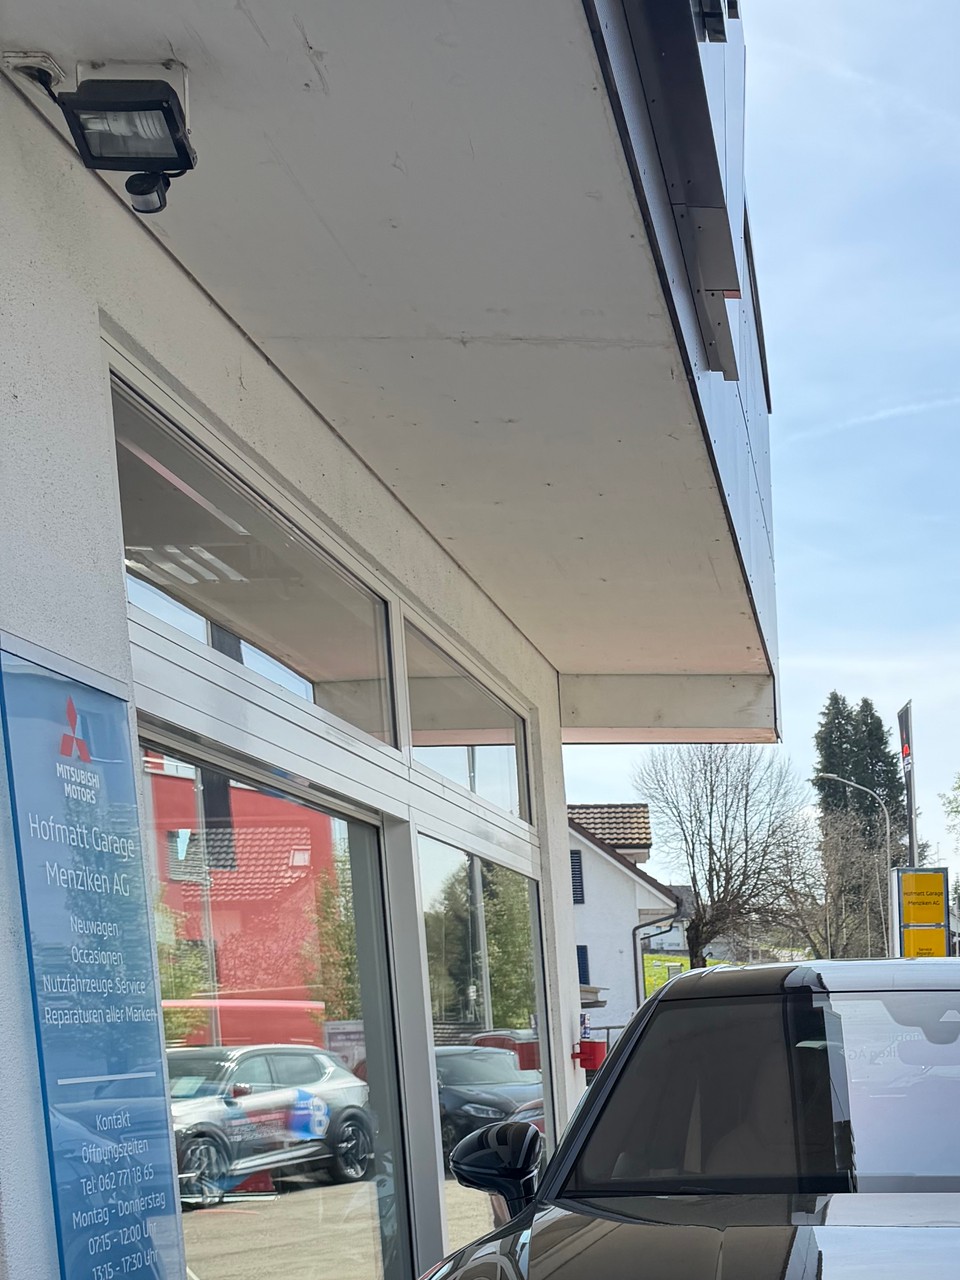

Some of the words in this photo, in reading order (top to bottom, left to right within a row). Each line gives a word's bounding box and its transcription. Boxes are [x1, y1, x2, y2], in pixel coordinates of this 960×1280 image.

[55, 762, 100, 789] MITSUBISHI
[64, 783, 96, 804] MOTORS
[29, 812, 89, 849] Hofmatt
[91, 827, 135, 862] Garage
[45, 861, 110, 893] Menziken
[113, 872, 130, 897] AG
[70, 916, 119, 940] Neuwagen
[71, 946, 124, 965] Occasionen
[42, 974, 113, 997] Nutzfahrzeuge
[115, 977, 146, 994] Service
[44, 1006, 104, 1029] Reparaturen
[106, 1005, 124, 1023] aller
[125, 1006, 156, 1022] Marken
[96, 1111, 131, 1131] Kontakt
[81, 1138, 150, 1164] Öffnungszeiten
[98, 1172, 116, 1191] 062
[117, 1168, 132, 1187] 771
[132, 1166, 142, 1184] 18
[144, 1163, 154, 1180] 65
[72, 1207, 110, 1230] Montag
[117, 1191, 166, 1217] Donnerstag
[88, 1233, 111, 1255] 07:15
[119, 1224, 141, 1245] 12:00
[142, 1220, 156, 1238] Uhr
[121, 1252, 142, 1273] 17:30
[144, 1248, 159, 1266] Uhr
